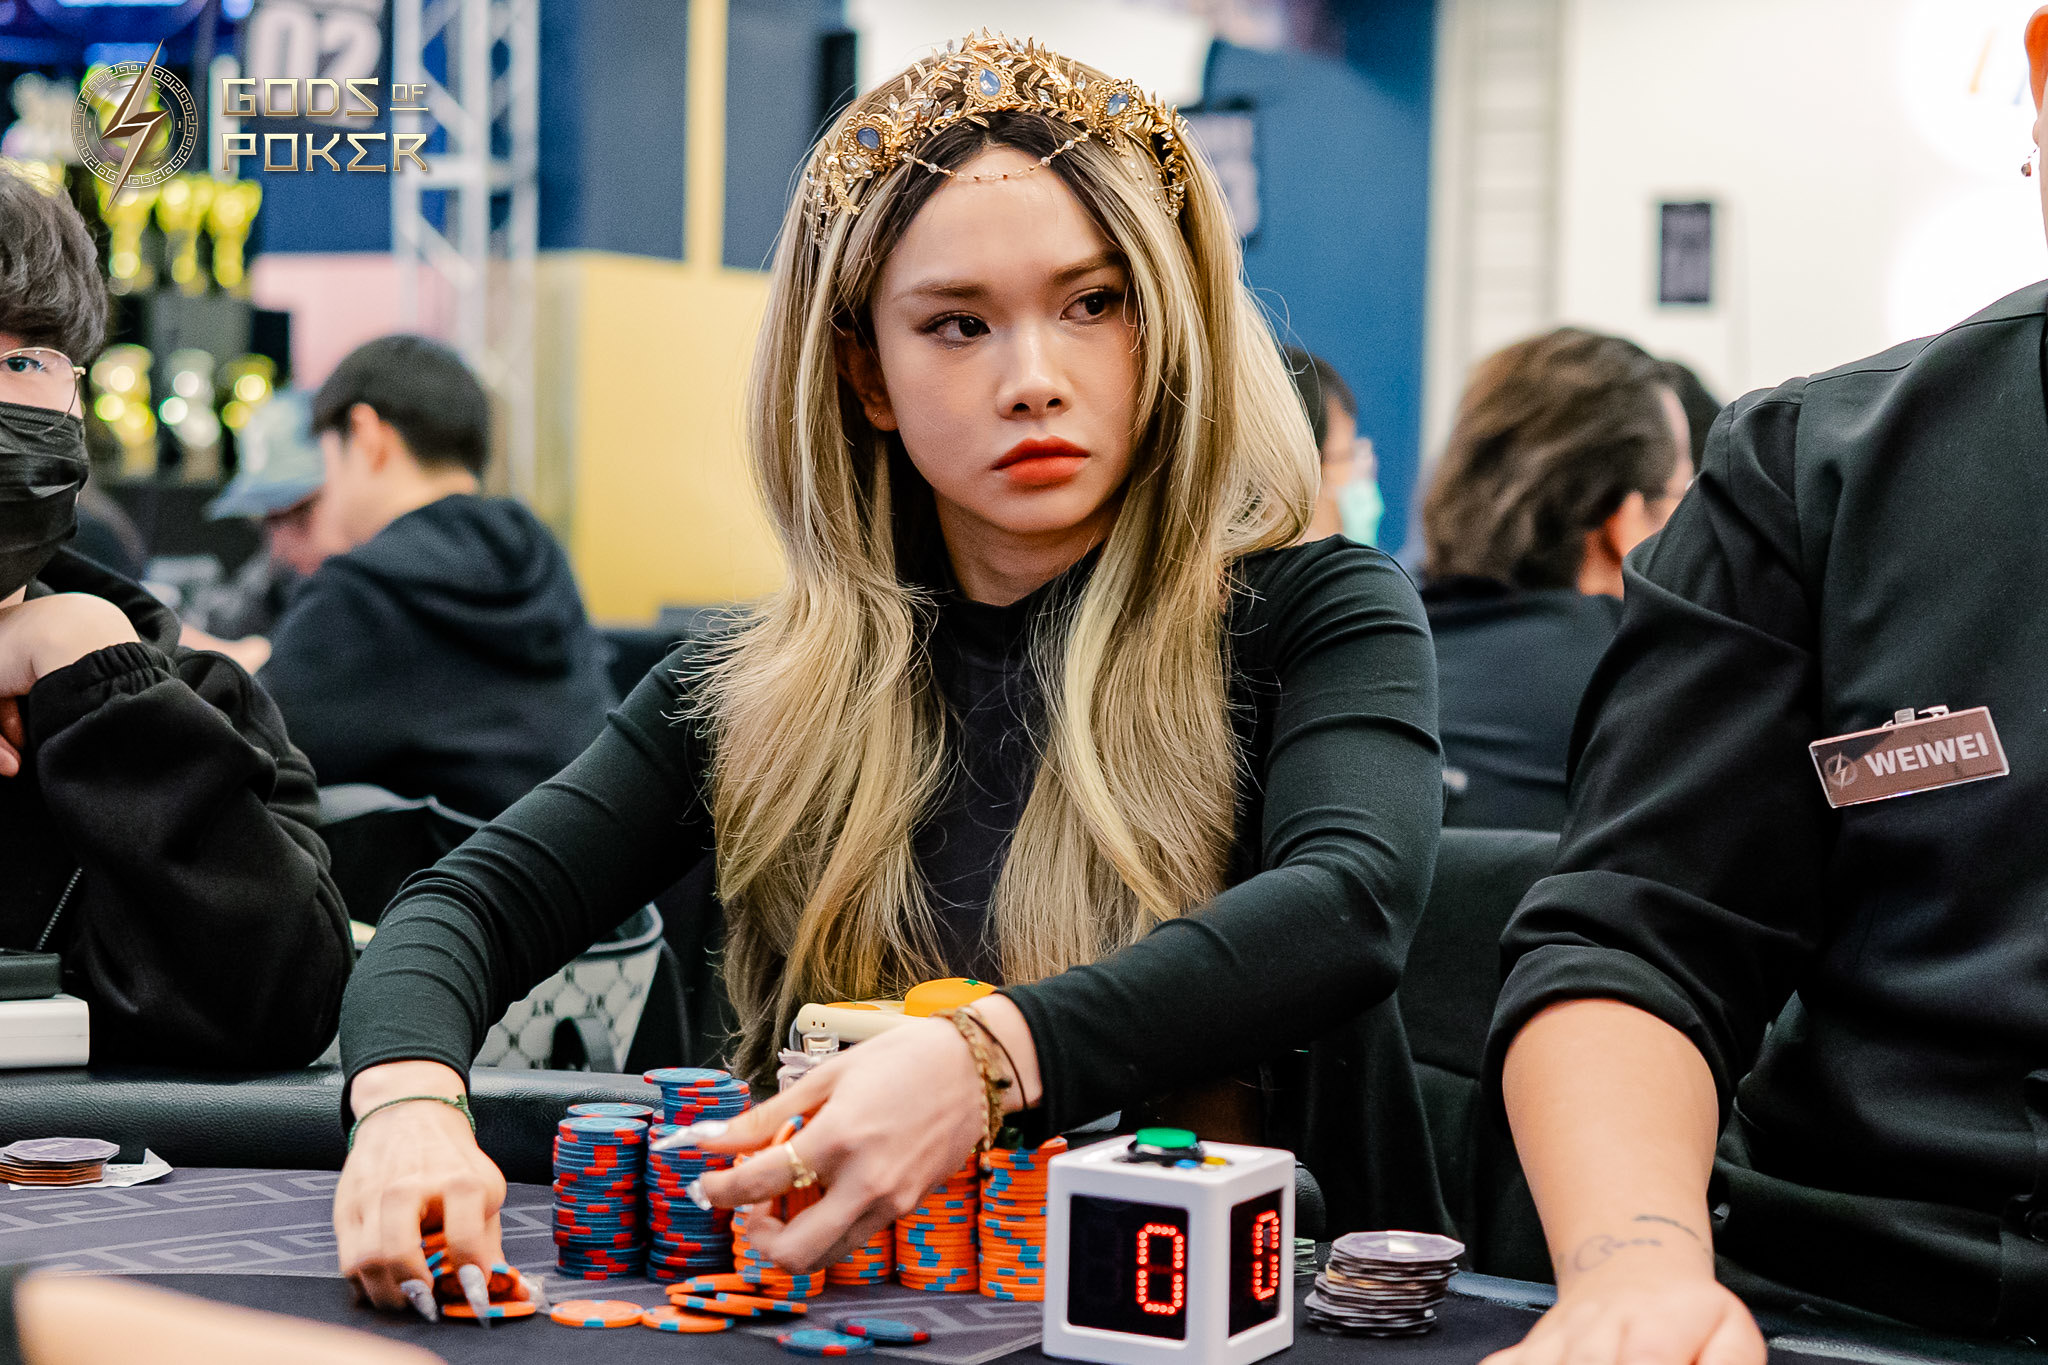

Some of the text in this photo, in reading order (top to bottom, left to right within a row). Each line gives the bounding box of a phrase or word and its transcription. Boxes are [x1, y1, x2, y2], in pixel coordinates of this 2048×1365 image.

[252, 8, 382, 130] 02
[1864, 731, 1990, 777] WEIWEI
[1136, 1222, 1185, 1315] 0
[1253, 1209, 1280, 1301] 0
